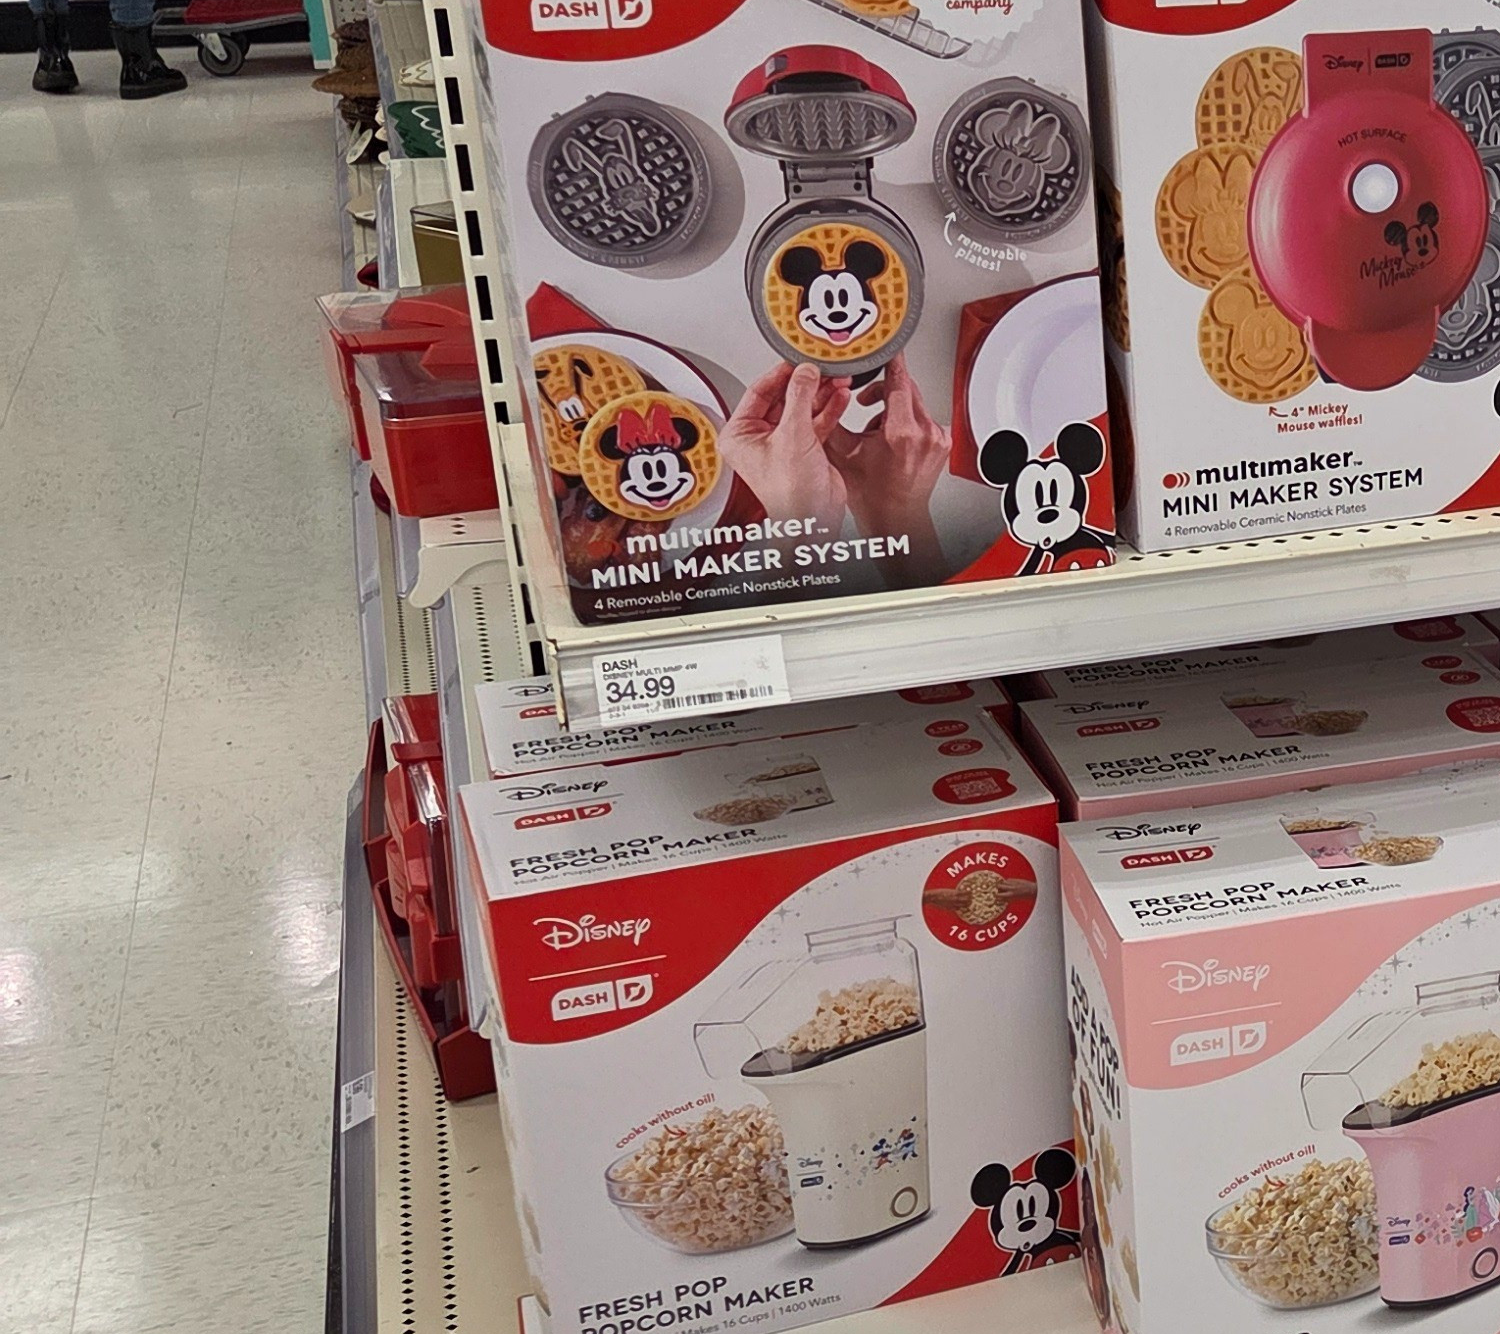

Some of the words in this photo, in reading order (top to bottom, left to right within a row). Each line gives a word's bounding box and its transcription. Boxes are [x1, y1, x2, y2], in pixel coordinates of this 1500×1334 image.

[538, 2, 599, 20] DASH
[1278, 418, 1314, 433] Mouse
[1317, 414, 1362, 429] waffles!
[1308, 402, 1348, 418] Mickey
[1162, 496, 1218, 518] MINI
[1230, 483, 1317, 511] MAKER
[1329, 468, 1423, 497] SYSTEM
[592, 562, 661, 589] MINI
[674, 548, 780, 580] MAKER
[795, 535, 910, 565] SYSTEM
[594, 599, 604, 609] 4
[607, 590, 682, 609] Removable
[685, 583, 741, 603] Ceramic
[744, 578, 799, 596] Nonstick
[802, 573, 840, 587] Plates
[602, 658, 637, 672] DASH
[607, 676, 675, 703] 34.99
[946, 852, 1009, 880] MAKES
[533, 915, 650, 954] Disney
[948, 925, 968, 943] 16
[973, 911, 1018, 943] CUPS
[1161, 959, 1270, 993] Disney
[559, 990, 608, 1009] DASH
[1176, 1035, 1224, 1056] DASH
[579, 1290, 663, 1324] FRESH
[675, 1276, 728, 1302] POP
[724, 1276, 815, 1314] MAKER
